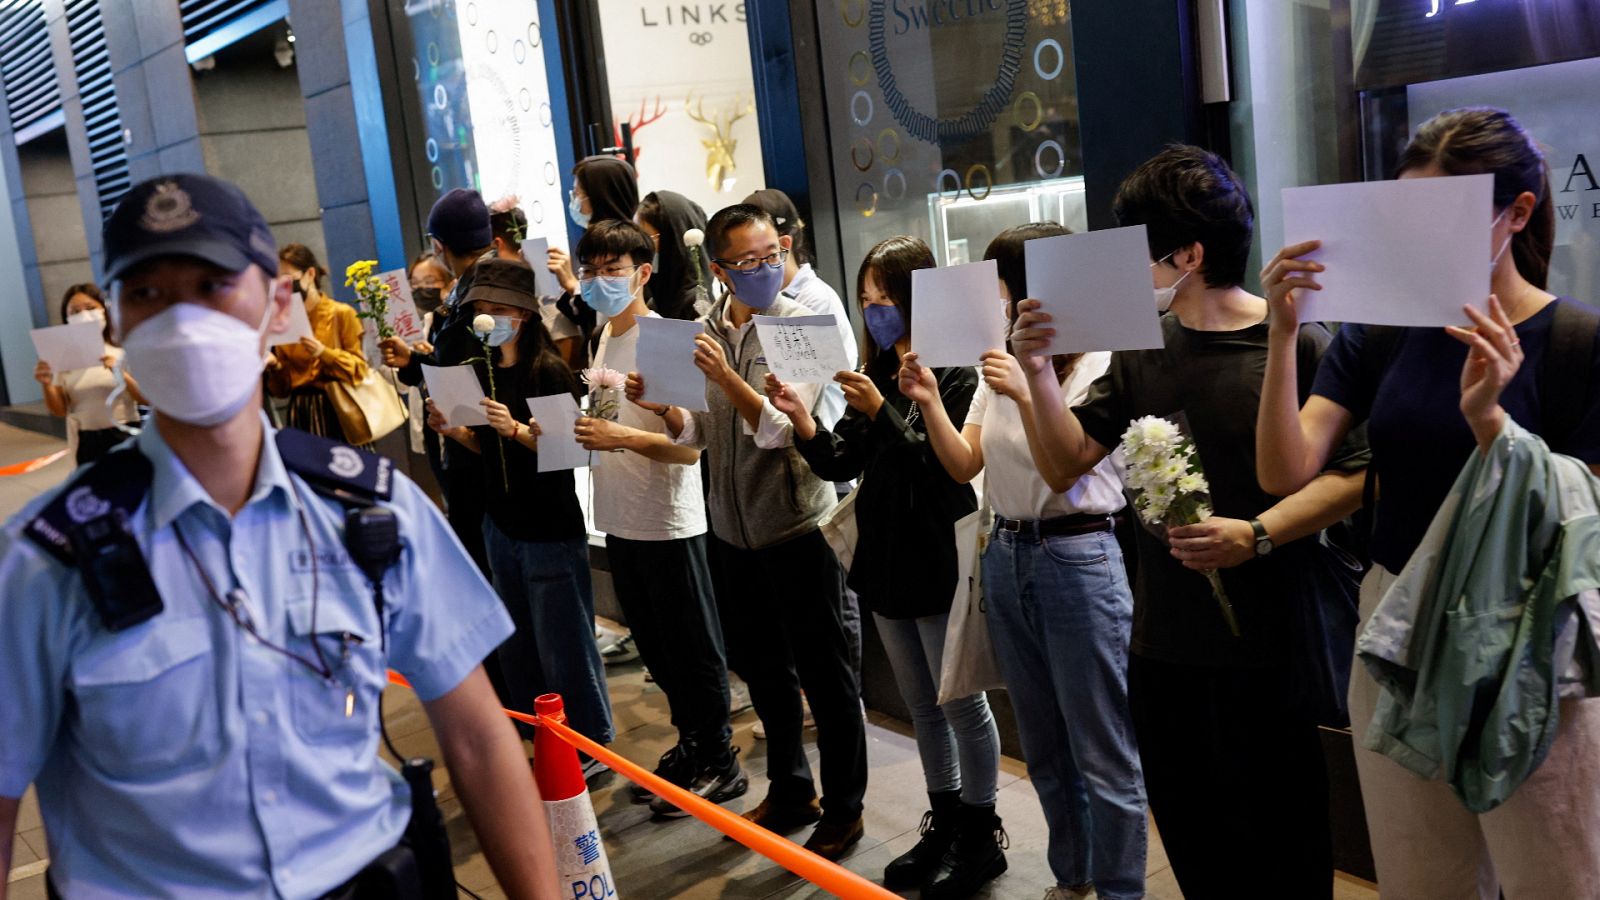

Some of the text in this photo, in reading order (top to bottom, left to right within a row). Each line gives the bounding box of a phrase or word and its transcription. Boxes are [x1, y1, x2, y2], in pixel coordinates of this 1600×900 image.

[641, 3, 746, 26] LINKS
[574, 831, 600, 865] 警
[572, 872, 614, 900] POL
